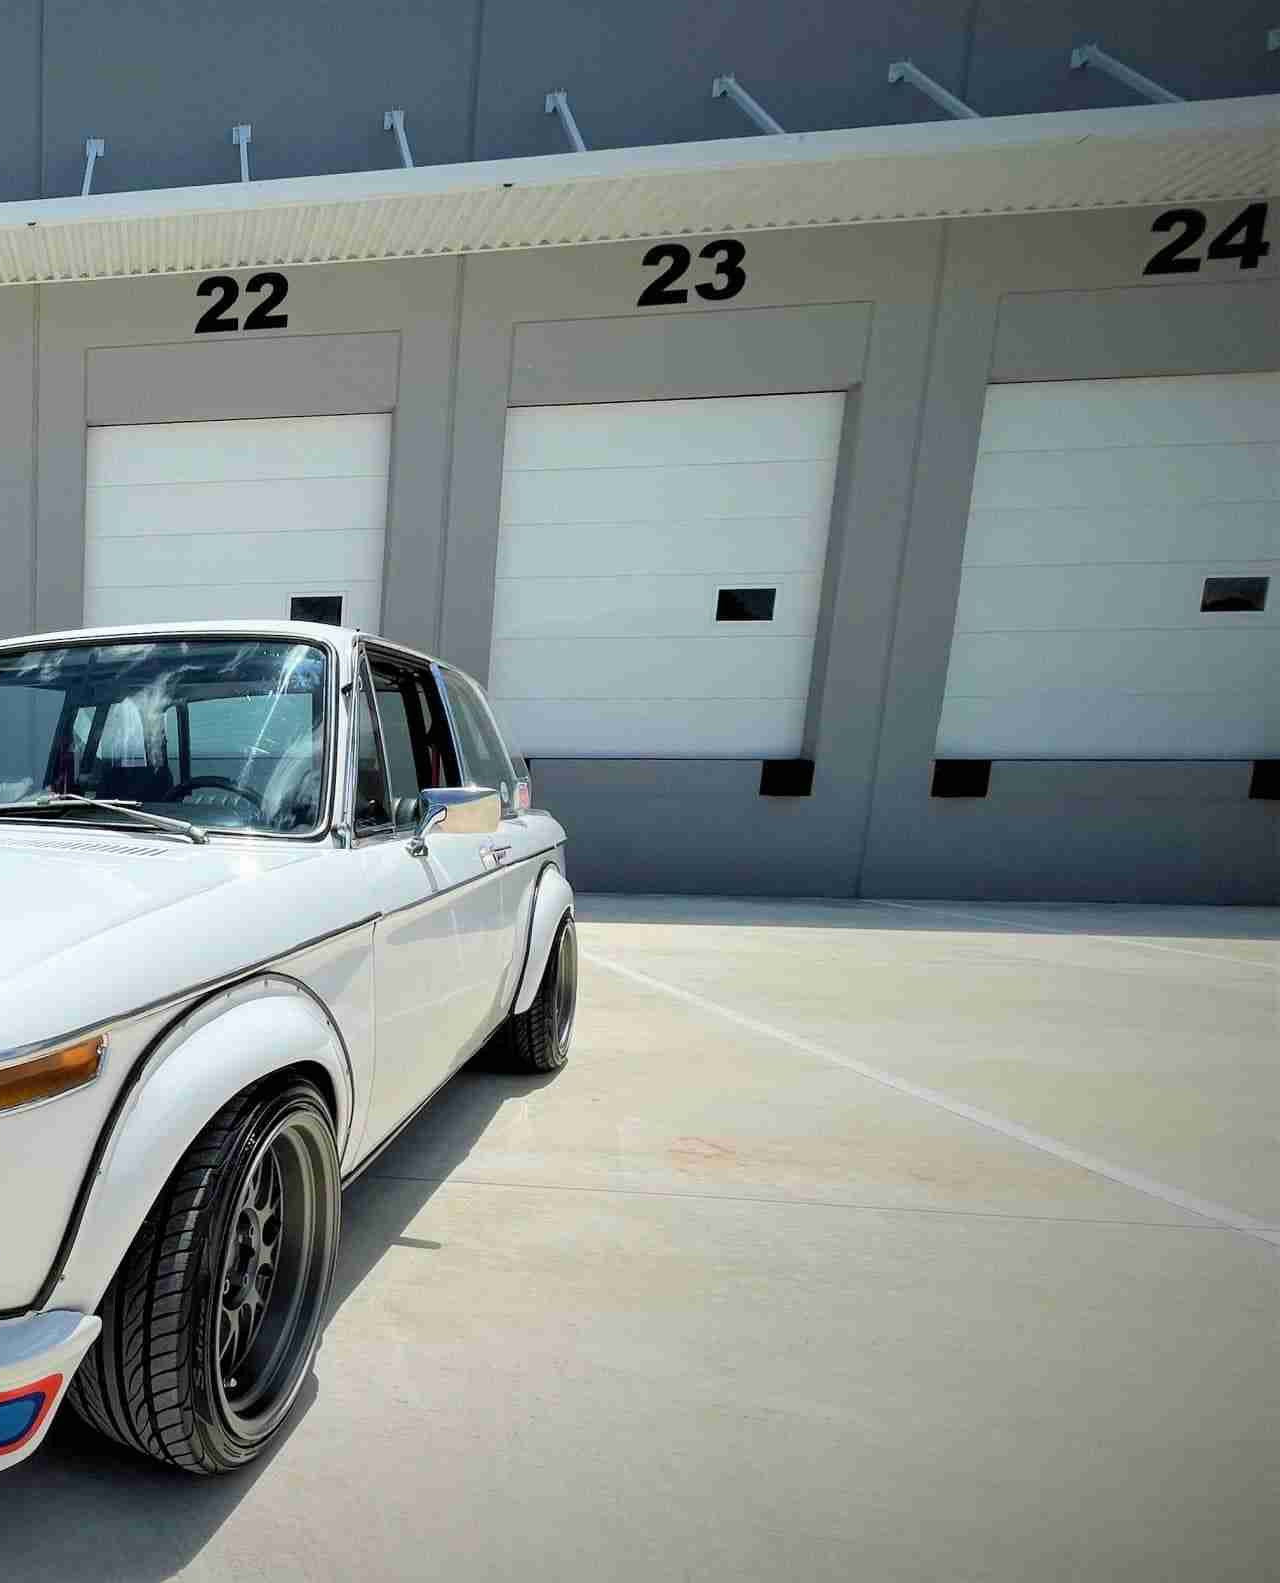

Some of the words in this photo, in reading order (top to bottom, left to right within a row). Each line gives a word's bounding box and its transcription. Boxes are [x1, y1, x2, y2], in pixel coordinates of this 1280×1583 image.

[637, 239, 746, 306] 23
[1142, 201, 1272, 277] 24
[195, 272, 288, 333] 22
